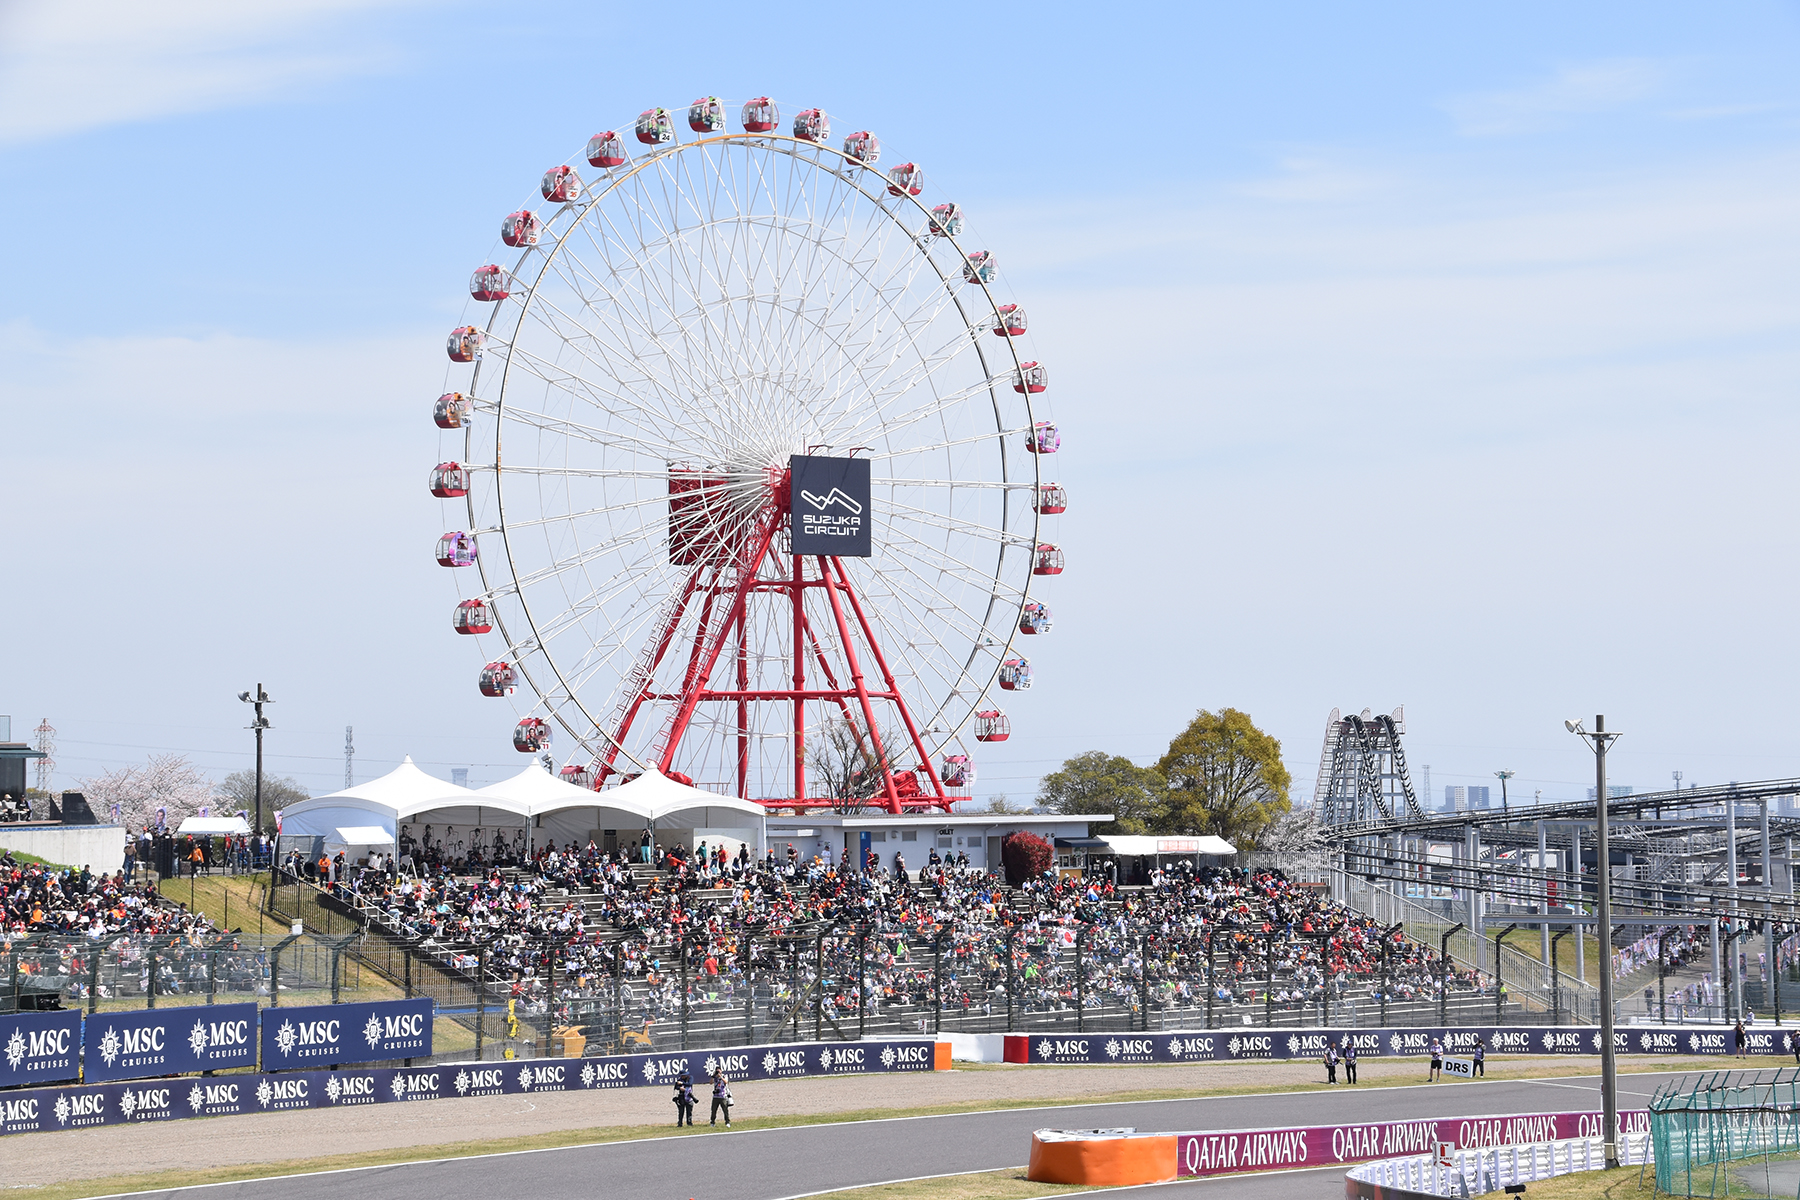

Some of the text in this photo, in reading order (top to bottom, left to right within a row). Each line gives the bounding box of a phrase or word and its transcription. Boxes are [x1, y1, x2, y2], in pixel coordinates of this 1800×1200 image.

[802, 514, 861, 525] SUZUKA
[804, 526, 859, 536] CIRCUIT
[210, 1020, 247, 1046] MSC
[298, 1020, 340, 1045] MSC
[384, 1014, 423, 1039] MSC
[28, 1029, 70, 1057] MSC
[122, 1026, 165, 1054] MSC
[384, 1040, 422, 1049] CRUISES
[1184, 1038, 1214, 1052] MSC
[1242, 1037, 1272, 1050] MSC
[1302, 1035, 1327, 1049] MSC
[1353, 1035, 1379, 1048] MSC
[1404, 1034, 1428, 1047] MSC
[1454, 1033, 1479, 1046] MSC
[1504, 1033, 1529, 1046] MSC
[1556, 1033, 1580, 1046] MSC
[1614, 1033, 1628, 1046] SC
[1653, 1034, 1677, 1046] MSC
[1701, 1034, 1725, 1047] MSC
[1749, 1034, 1772, 1047] MSC
[210, 1048, 247, 1058] CRUISES
[298, 1047, 340, 1057] CRUISES
[1055, 1040, 1089, 1055] MSC
[1122, 1040, 1153, 1054] MSC
[122, 1055, 165, 1067] CRUISES
[778, 1051, 805, 1068] MSC
[834, 1049, 865, 1064] MSC
[897, 1047, 928, 1063] MSC
[27, 1059, 69, 1071] CRUISES
[658, 1058, 688, 1076] MSC
[719, 1055, 749, 1071] MSC
[1445, 1062, 1469, 1073] DRS
[471, 1069, 503, 1088] MSC
[534, 1066, 565, 1084] MSC
[596, 1063, 628, 1081] MSC
[273, 1080, 308, 1099] MSC
[342, 1077, 374, 1095] MSC
[407, 1073, 439, 1092] MSC
[137, 1089, 170, 1110] MSC
[206, 1084, 238, 1104] MSC
[6, 1099, 38, 1121] MSC
[71, 1094, 104, 1116] MSC
[206, 1105, 239, 1113] CRUISES
[274, 1100, 309, 1109] CRUISES
[72, 1116, 104, 1126] CRUISES
[136, 1110, 170, 1120] CRUISES
[7, 1122, 40, 1131] CRUISES
[1460, 1116, 1557, 1149] QATAR AIRWAYS
[1578, 1114, 1621, 1138] QATR
[1332, 1122, 1438, 1162] QATAR AIRWAYS
[1186, 1131, 1307, 1174] QATAR AIRWAYS
